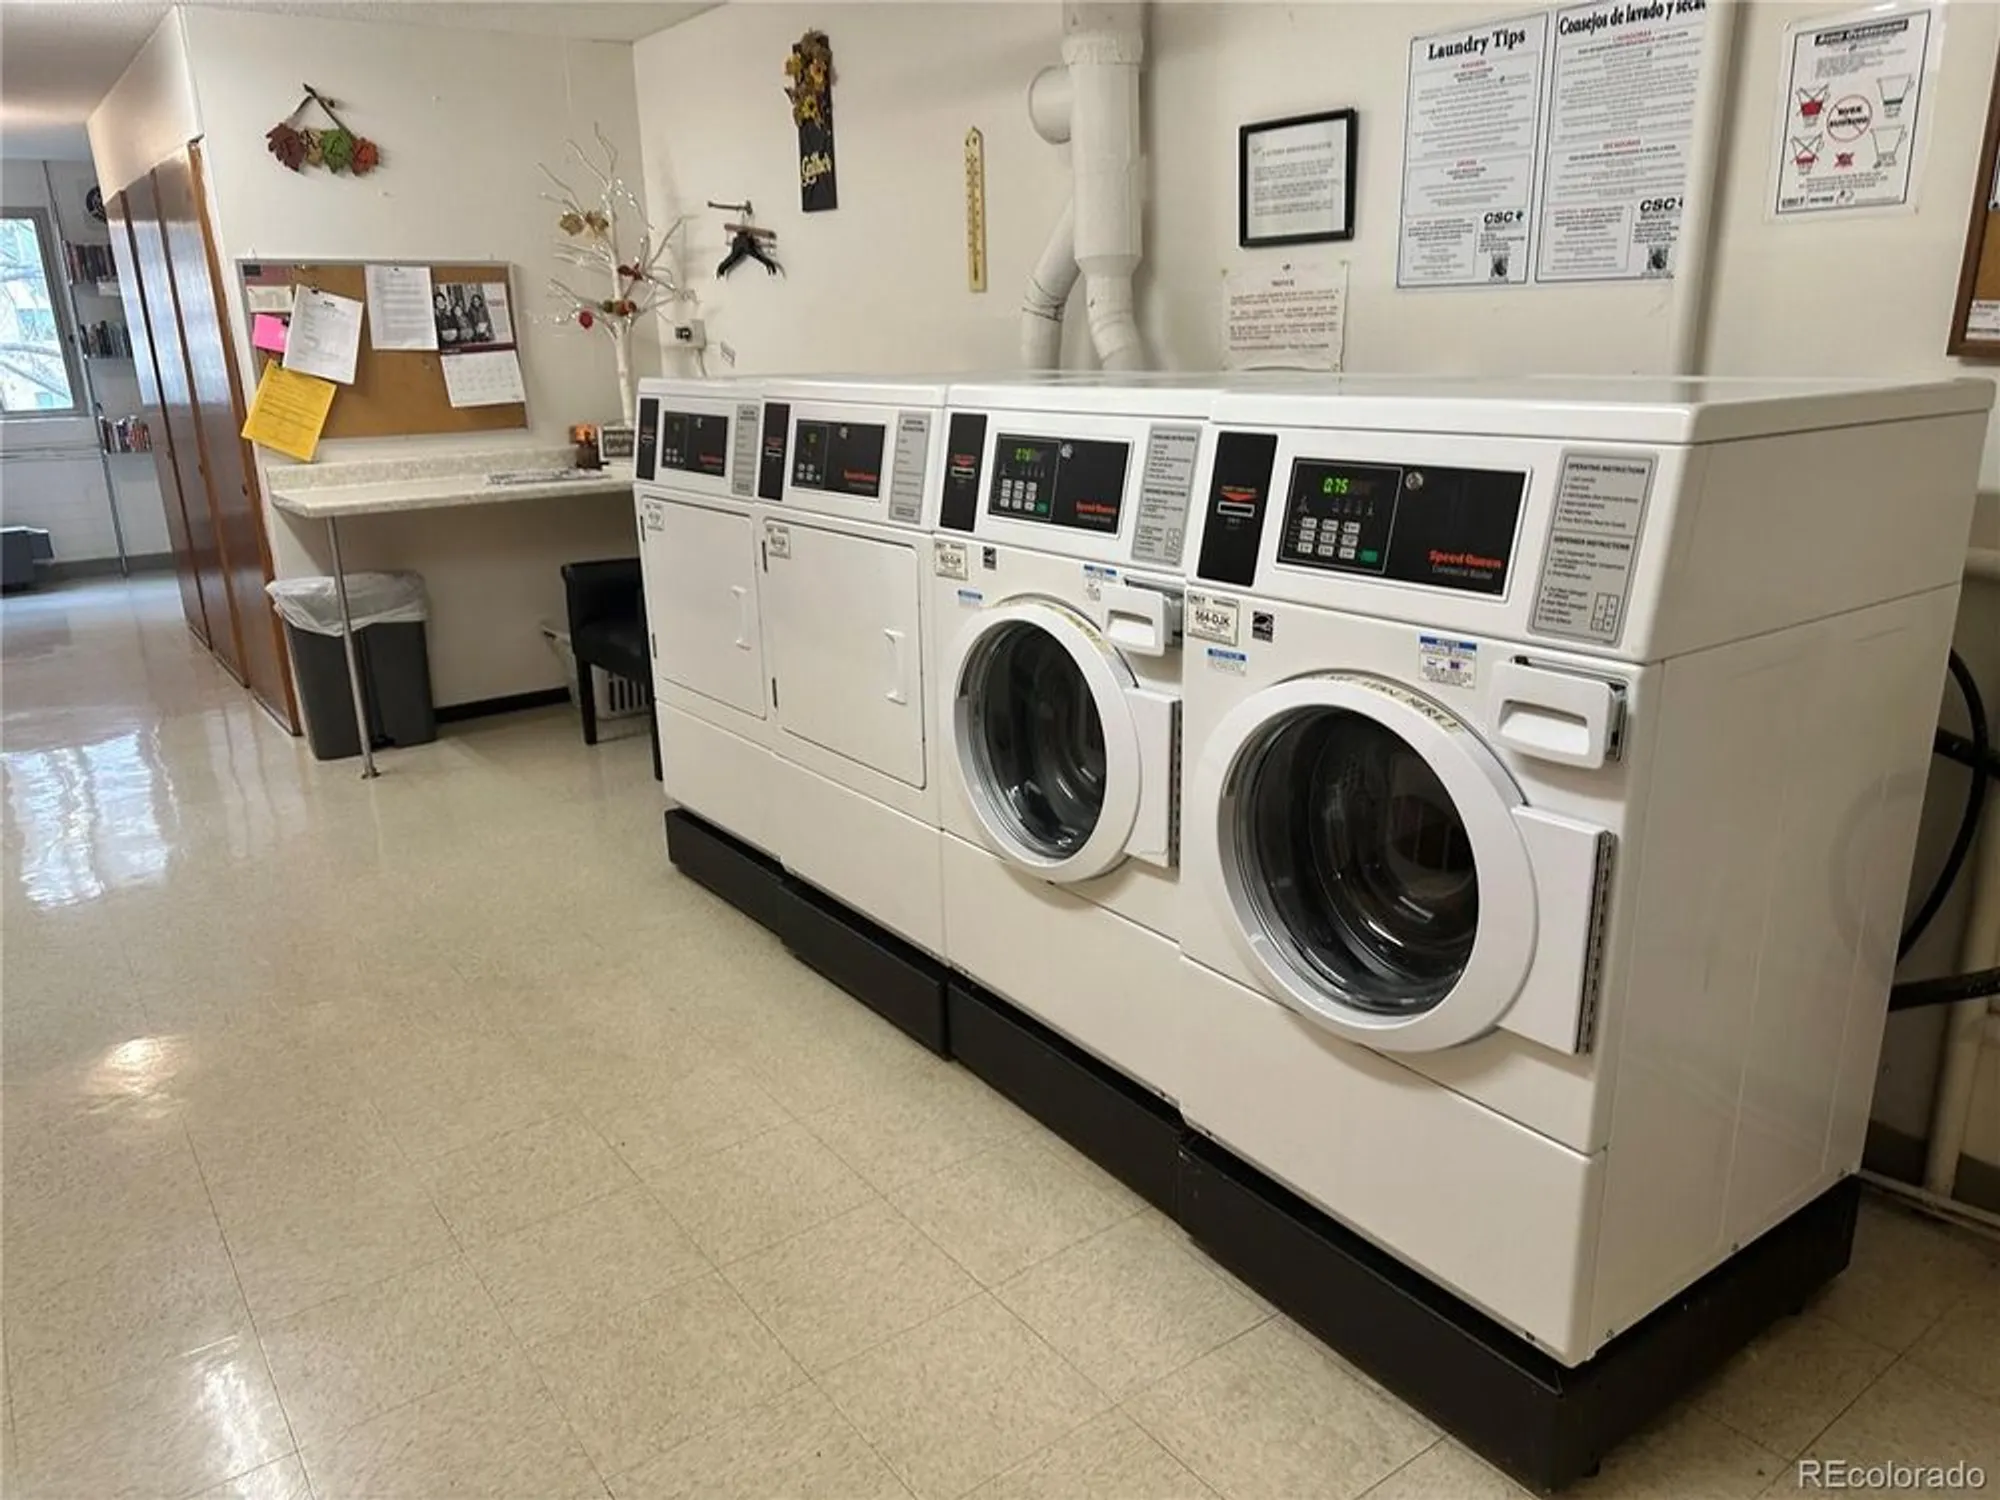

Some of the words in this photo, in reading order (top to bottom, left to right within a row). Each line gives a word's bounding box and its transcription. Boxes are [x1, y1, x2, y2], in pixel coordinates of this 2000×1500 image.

[1560, 12, 1607, 35] Consejos
[1610, 7, 1624, 26] de
[1626, 0, 1664, 23] lavado
[1666, 3, 1674, 22] y
[1428, 35, 1489, 60] Laundry
[1492, 29, 1526, 50] Tips
[1640, 197, 1676, 212] CSC
[1484, 211, 1513, 225] CSC
[1429, 550, 1464, 567] Speed
[1465, 554, 1503, 568] Queen
